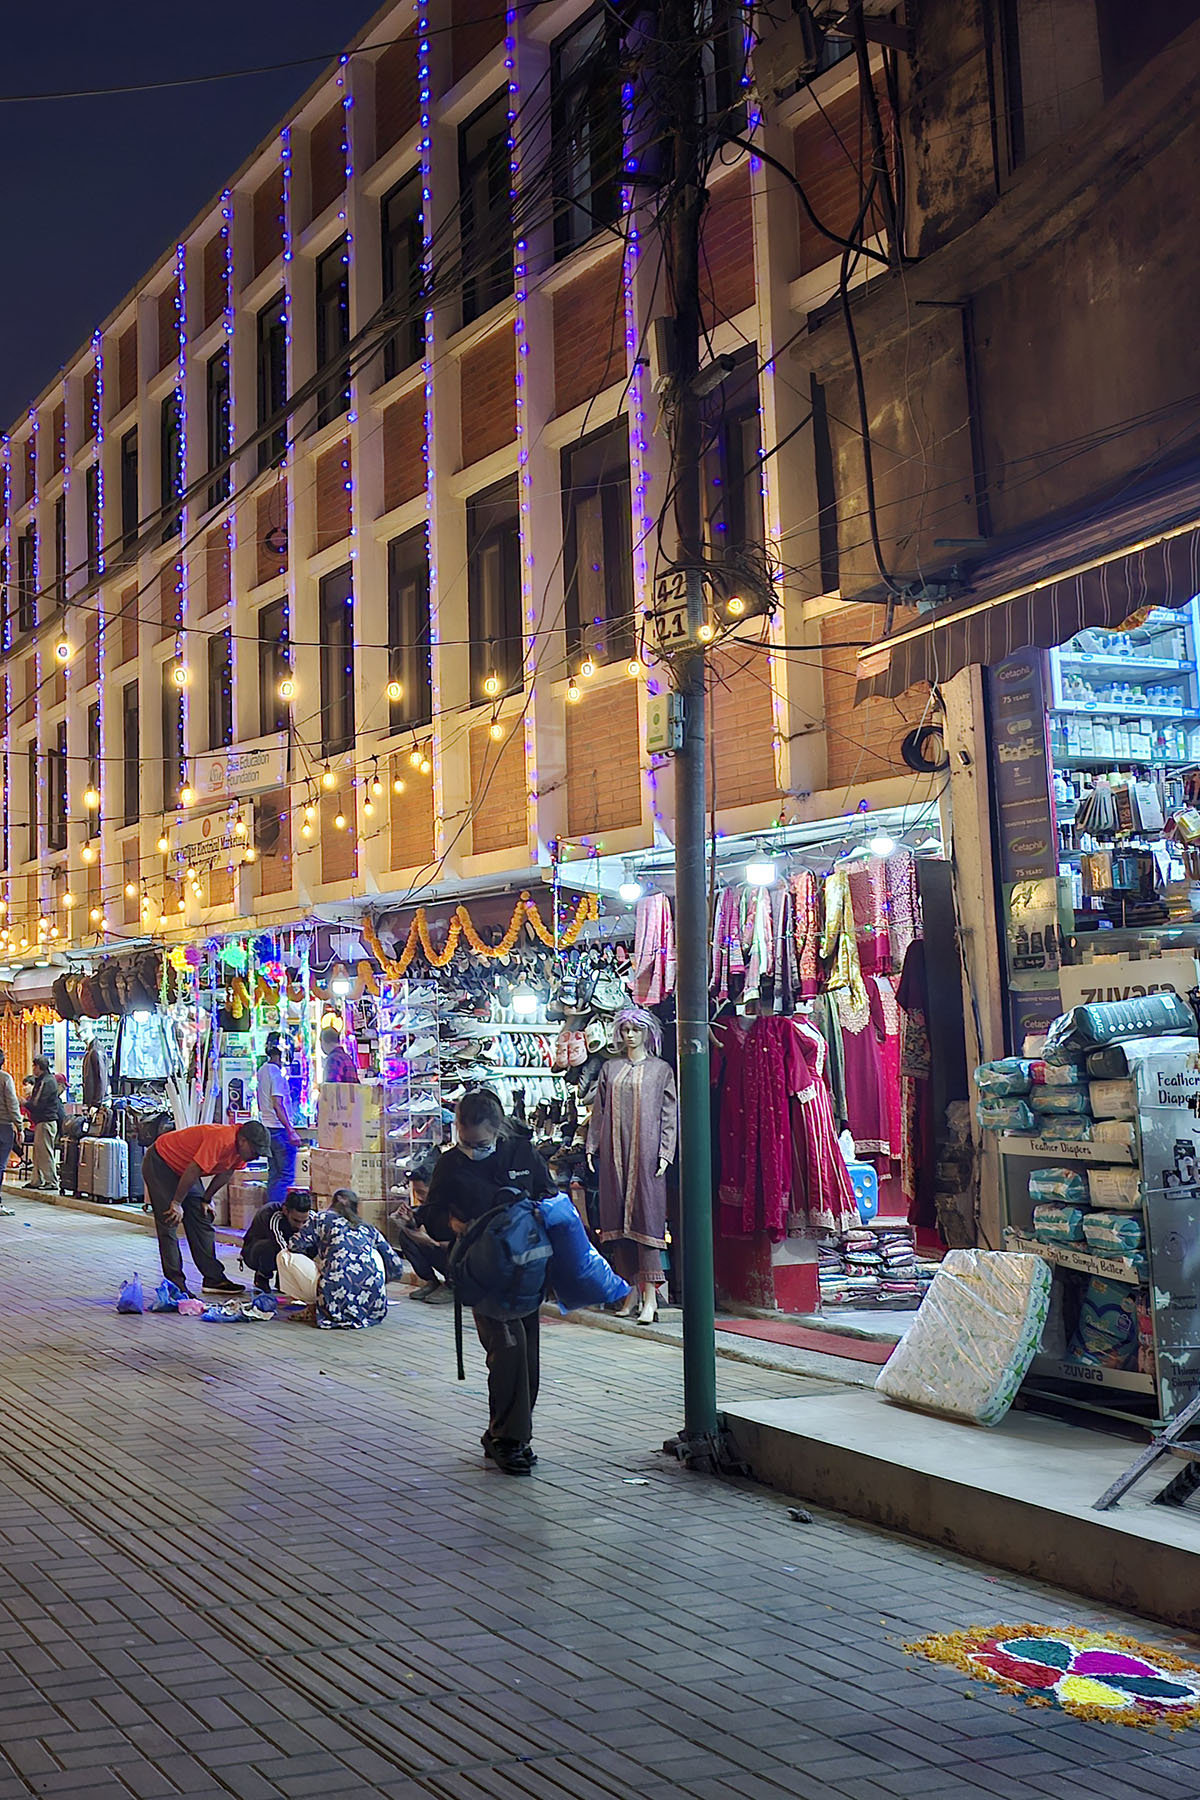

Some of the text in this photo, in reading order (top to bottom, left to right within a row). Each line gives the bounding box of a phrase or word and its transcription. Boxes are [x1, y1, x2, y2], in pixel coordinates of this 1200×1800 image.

[1000, 665, 1031, 680] Cetaphil
[1003, 695, 1012, 704] 75
[240, 753, 269, 769] Education
[227, 770, 260, 787] Foundation
[1012, 840, 1042, 852] Cetaphil
[1016, 869, 1024, 877] 75
[1024, 1019, 1051, 1030] Cetaph
[1157, 1071, 1200, 1087] Feather
[1030, 1139, 1091, 1157] Feather Diapers
[1072, 1253, 1099, 1274] Simply
[1100, 1260, 1126, 1276] Better.
[1063, 1364, 1104, 1382] zuvara
[1171, 1364, 1200, 1377] Thinne
[1171, 1377, 1199, 1391] Simpl
